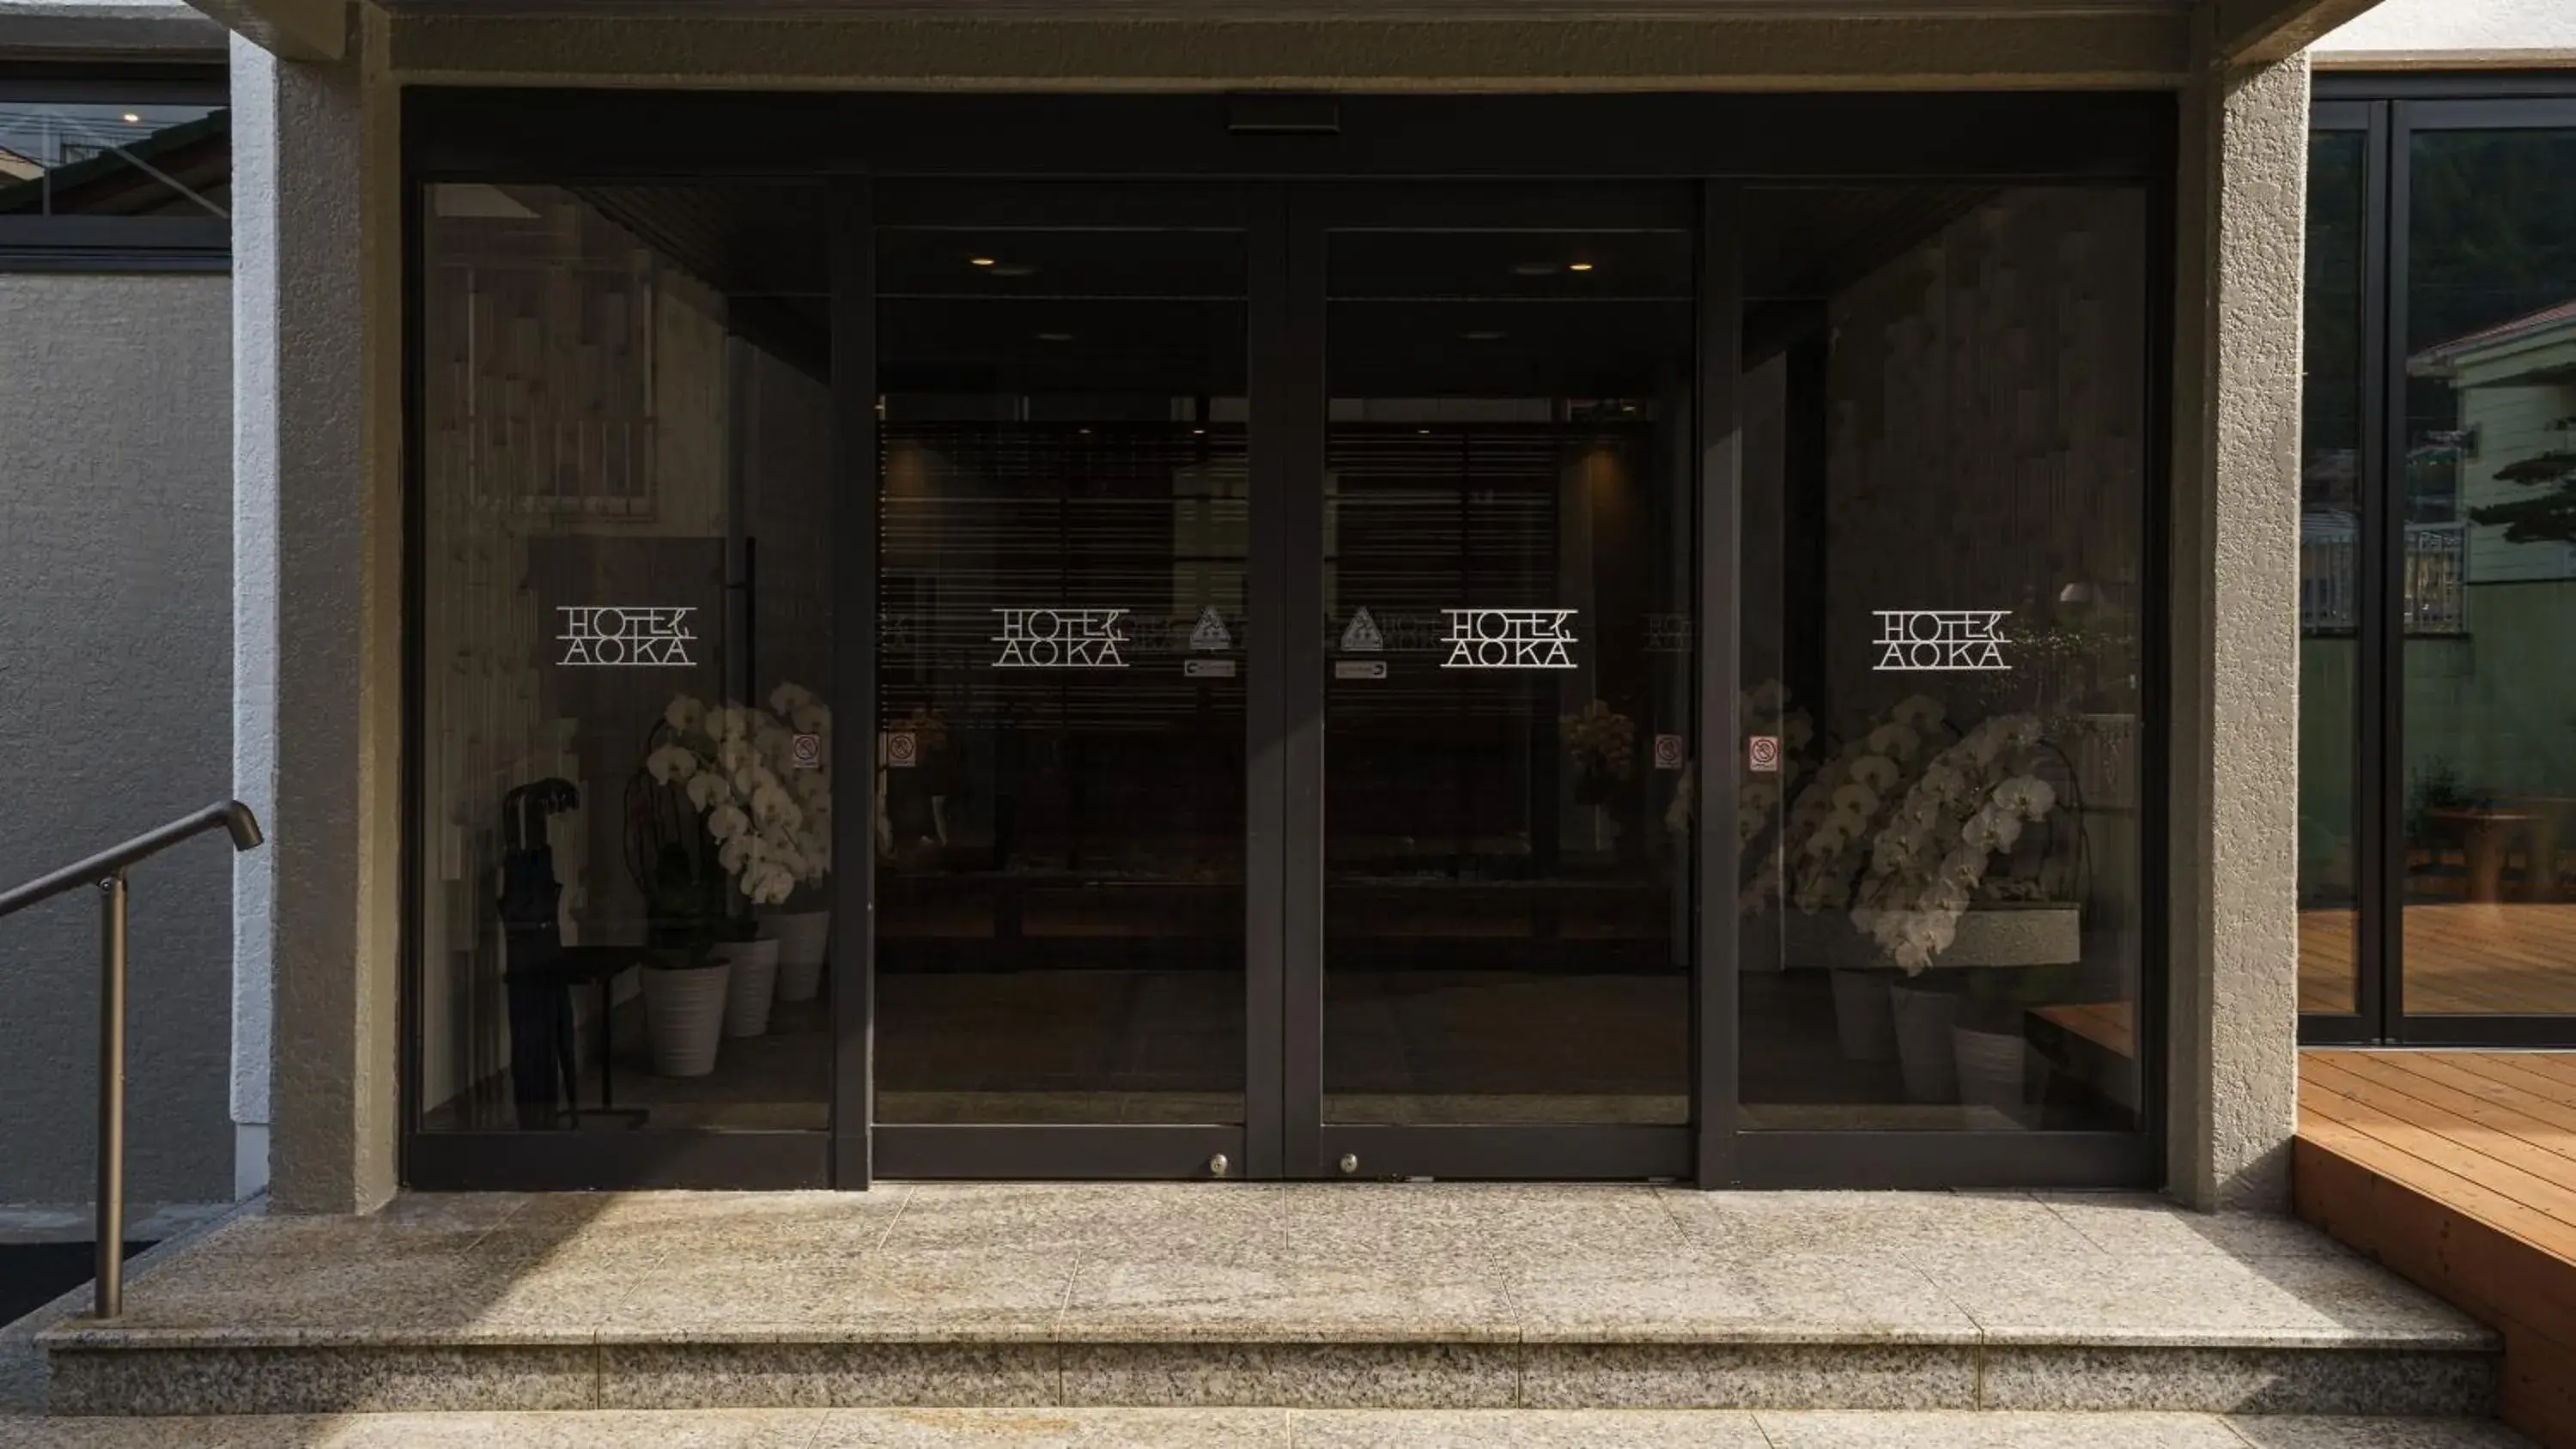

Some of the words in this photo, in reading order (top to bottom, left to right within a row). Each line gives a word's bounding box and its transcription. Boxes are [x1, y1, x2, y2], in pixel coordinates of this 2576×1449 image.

[564, 637, 690, 665] AOKA
[998, 638, 1123, 668] AOKA
[1447, 638, 1572, 669] AOKA
[1879, 640, 2005, 670] AOKA
